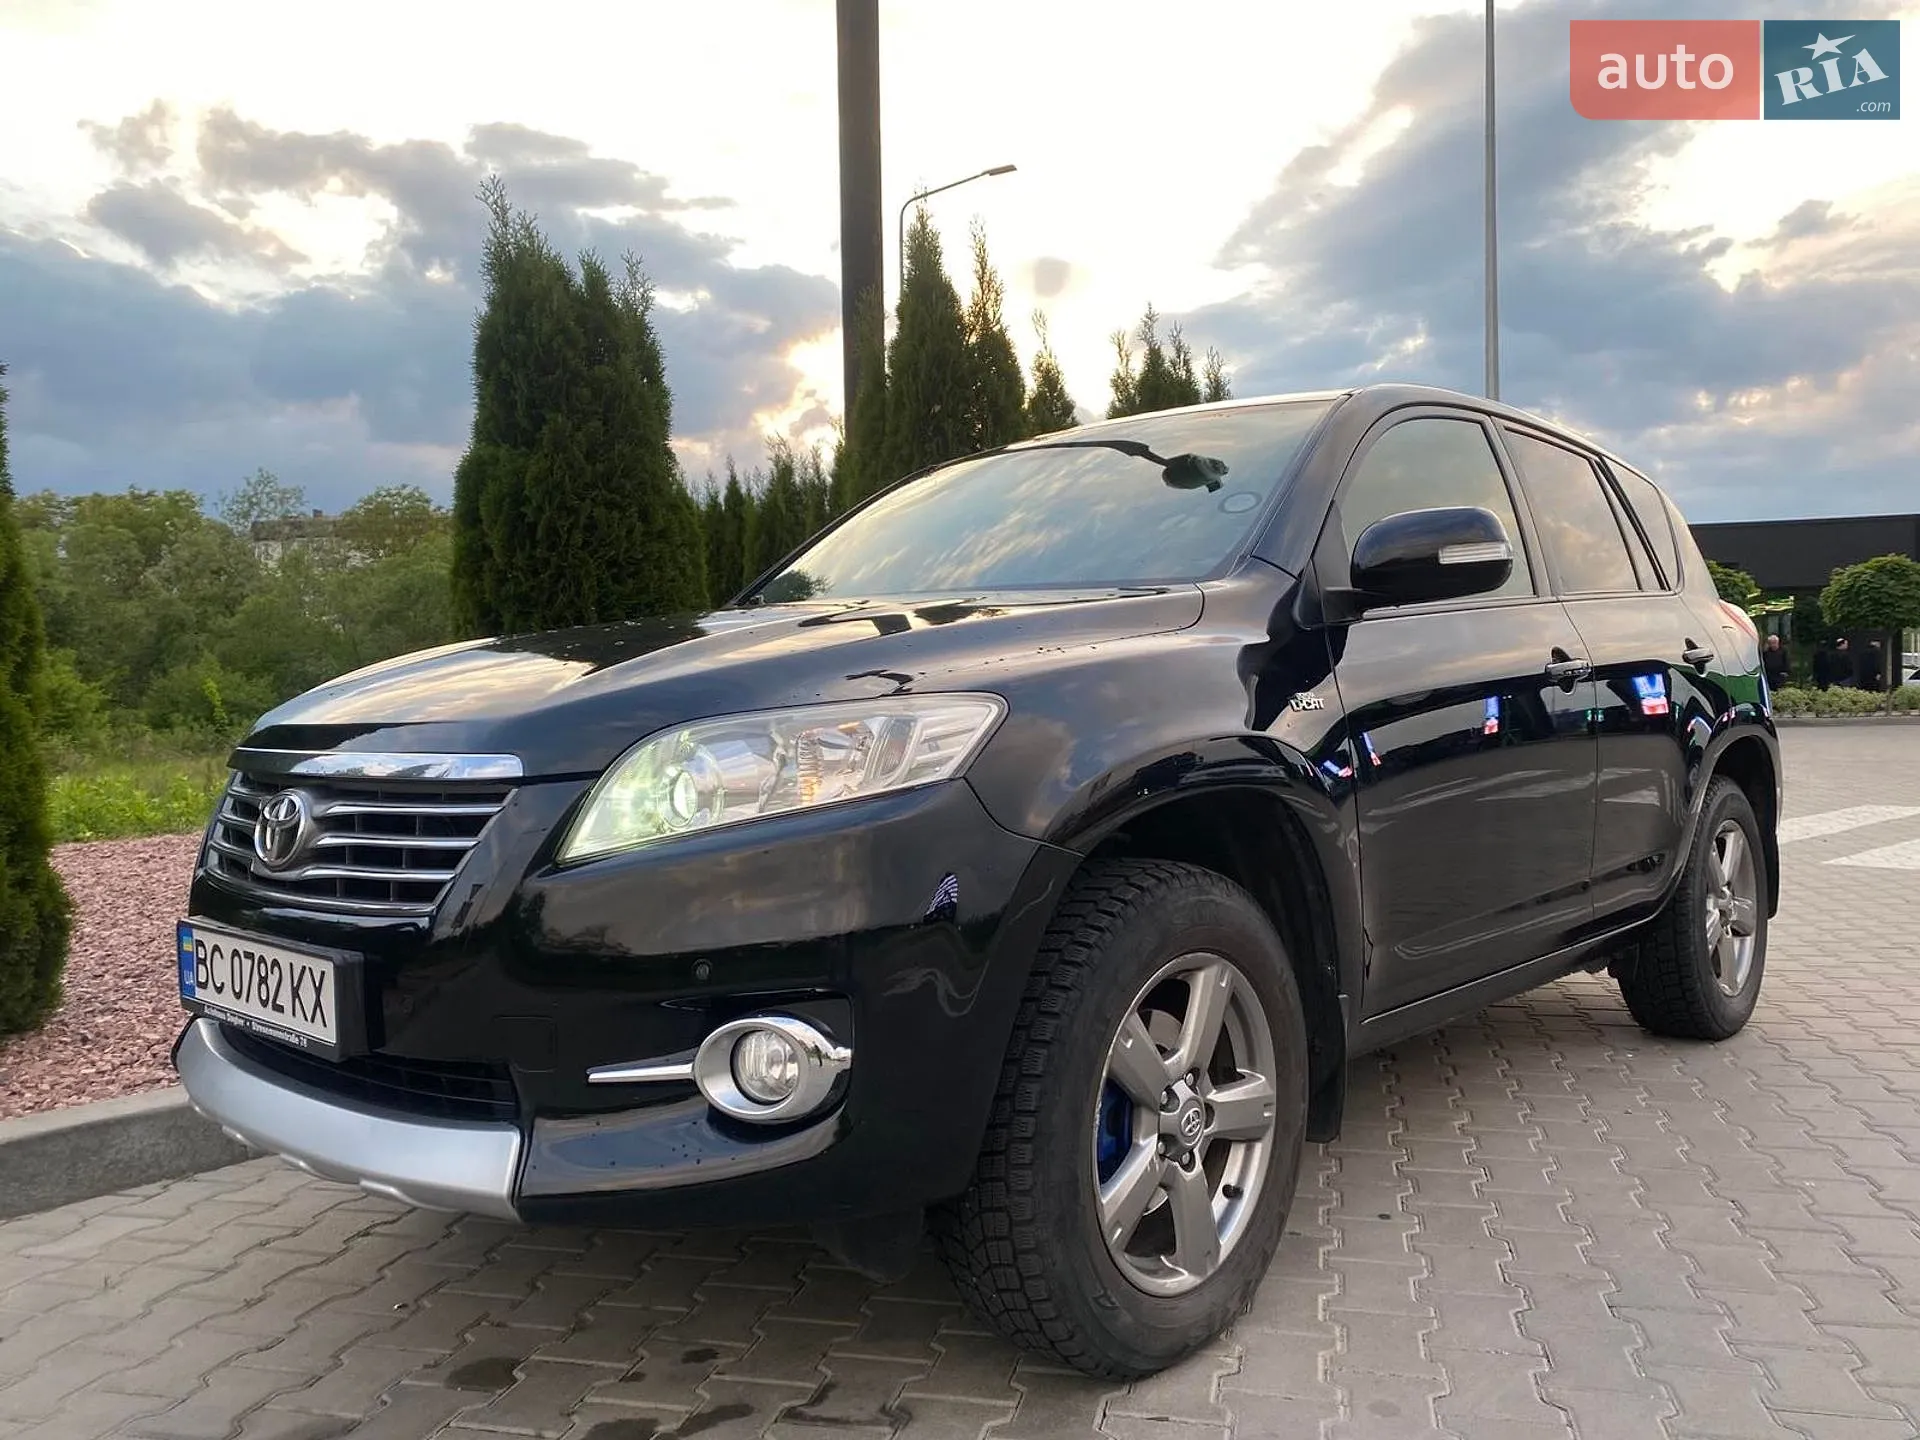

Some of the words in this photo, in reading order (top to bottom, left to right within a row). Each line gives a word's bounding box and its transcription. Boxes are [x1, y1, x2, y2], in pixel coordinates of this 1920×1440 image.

[195, 939, 225, 995] BC
[230, 948, 285, 1014] 0782
[289, 962, 327, 1028] KX
